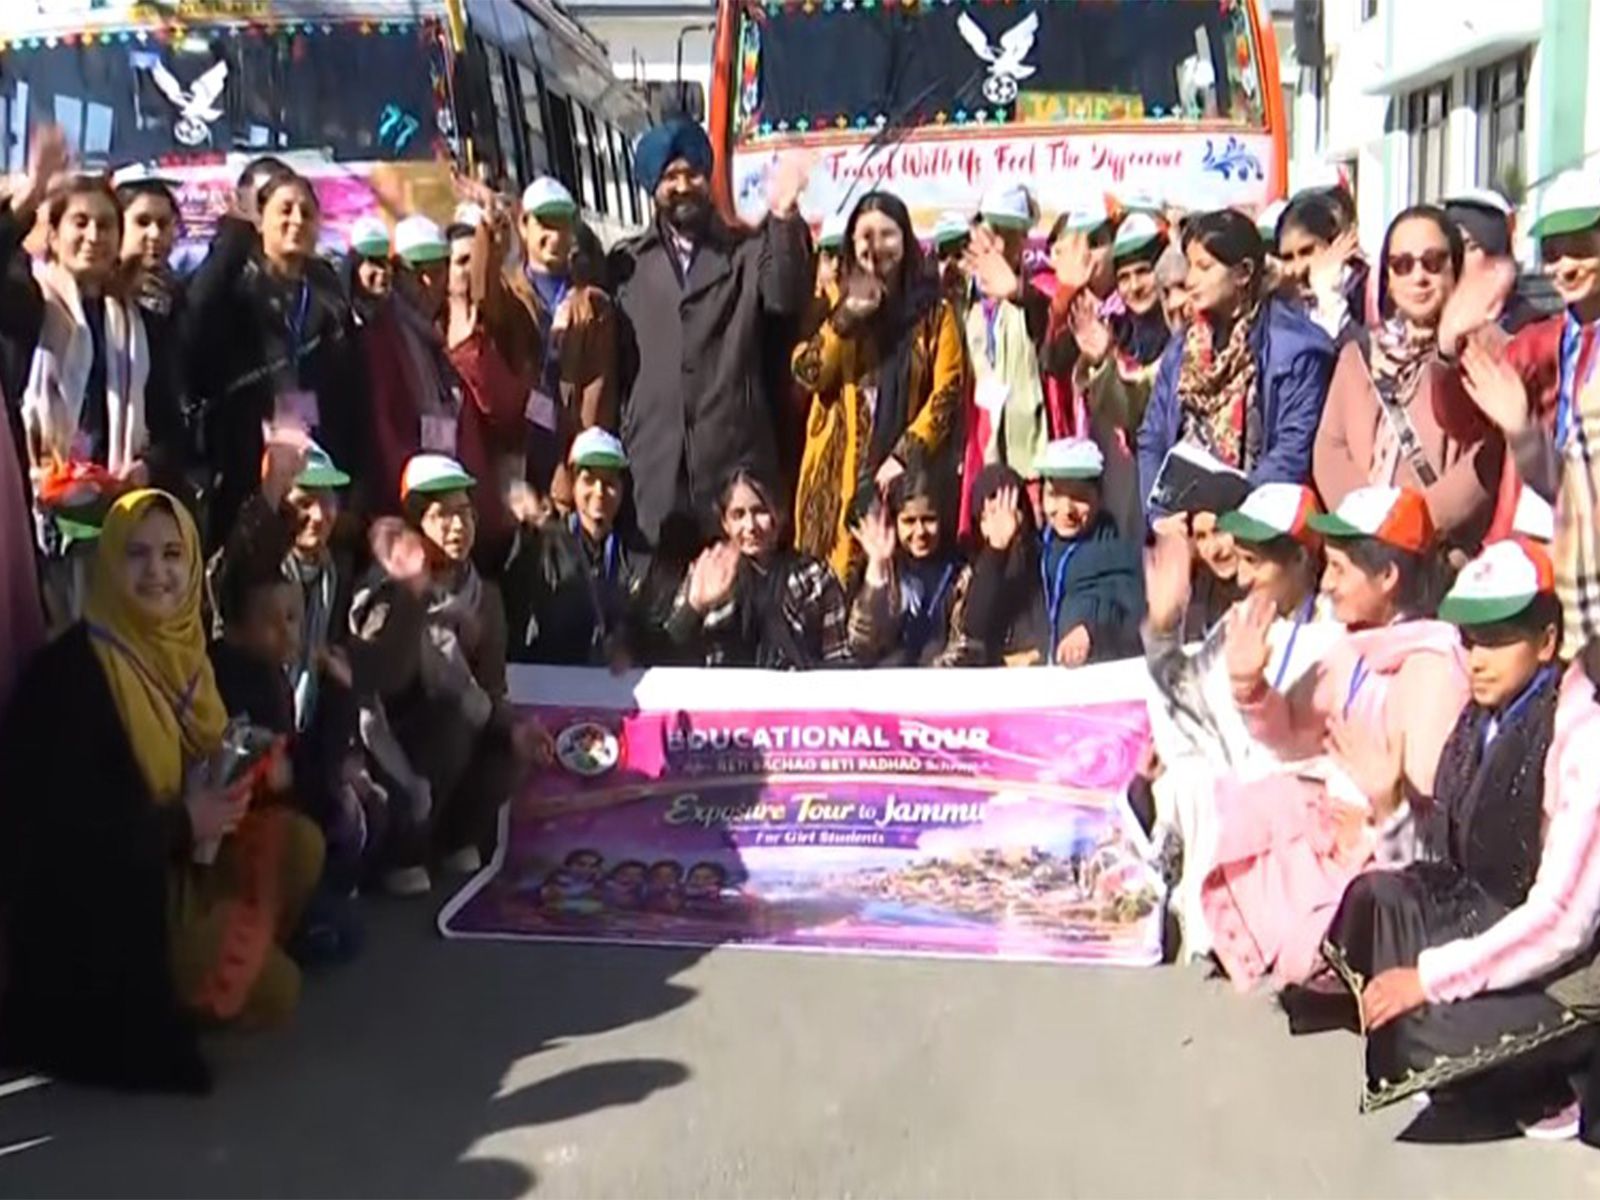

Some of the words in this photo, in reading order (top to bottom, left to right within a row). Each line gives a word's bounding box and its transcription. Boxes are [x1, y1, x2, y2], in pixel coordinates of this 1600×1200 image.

[902, 147, 952, 178] With
[995, 145, 1036, 174] Feel
[1046, 141, 1080, 171] The
[668, 725, 891, 749] EDUCATIONAL
[902, 726, 991, 750] TOUR
[664, 793, 785, 827] Exposure
[790, 793, 855, 822] Tour
[859, 806, 877, 820] to
[875, 793, 986, 828] Jammu
[784, 831, 815, 845] Girl
[819, 831, 884, 846] Students
